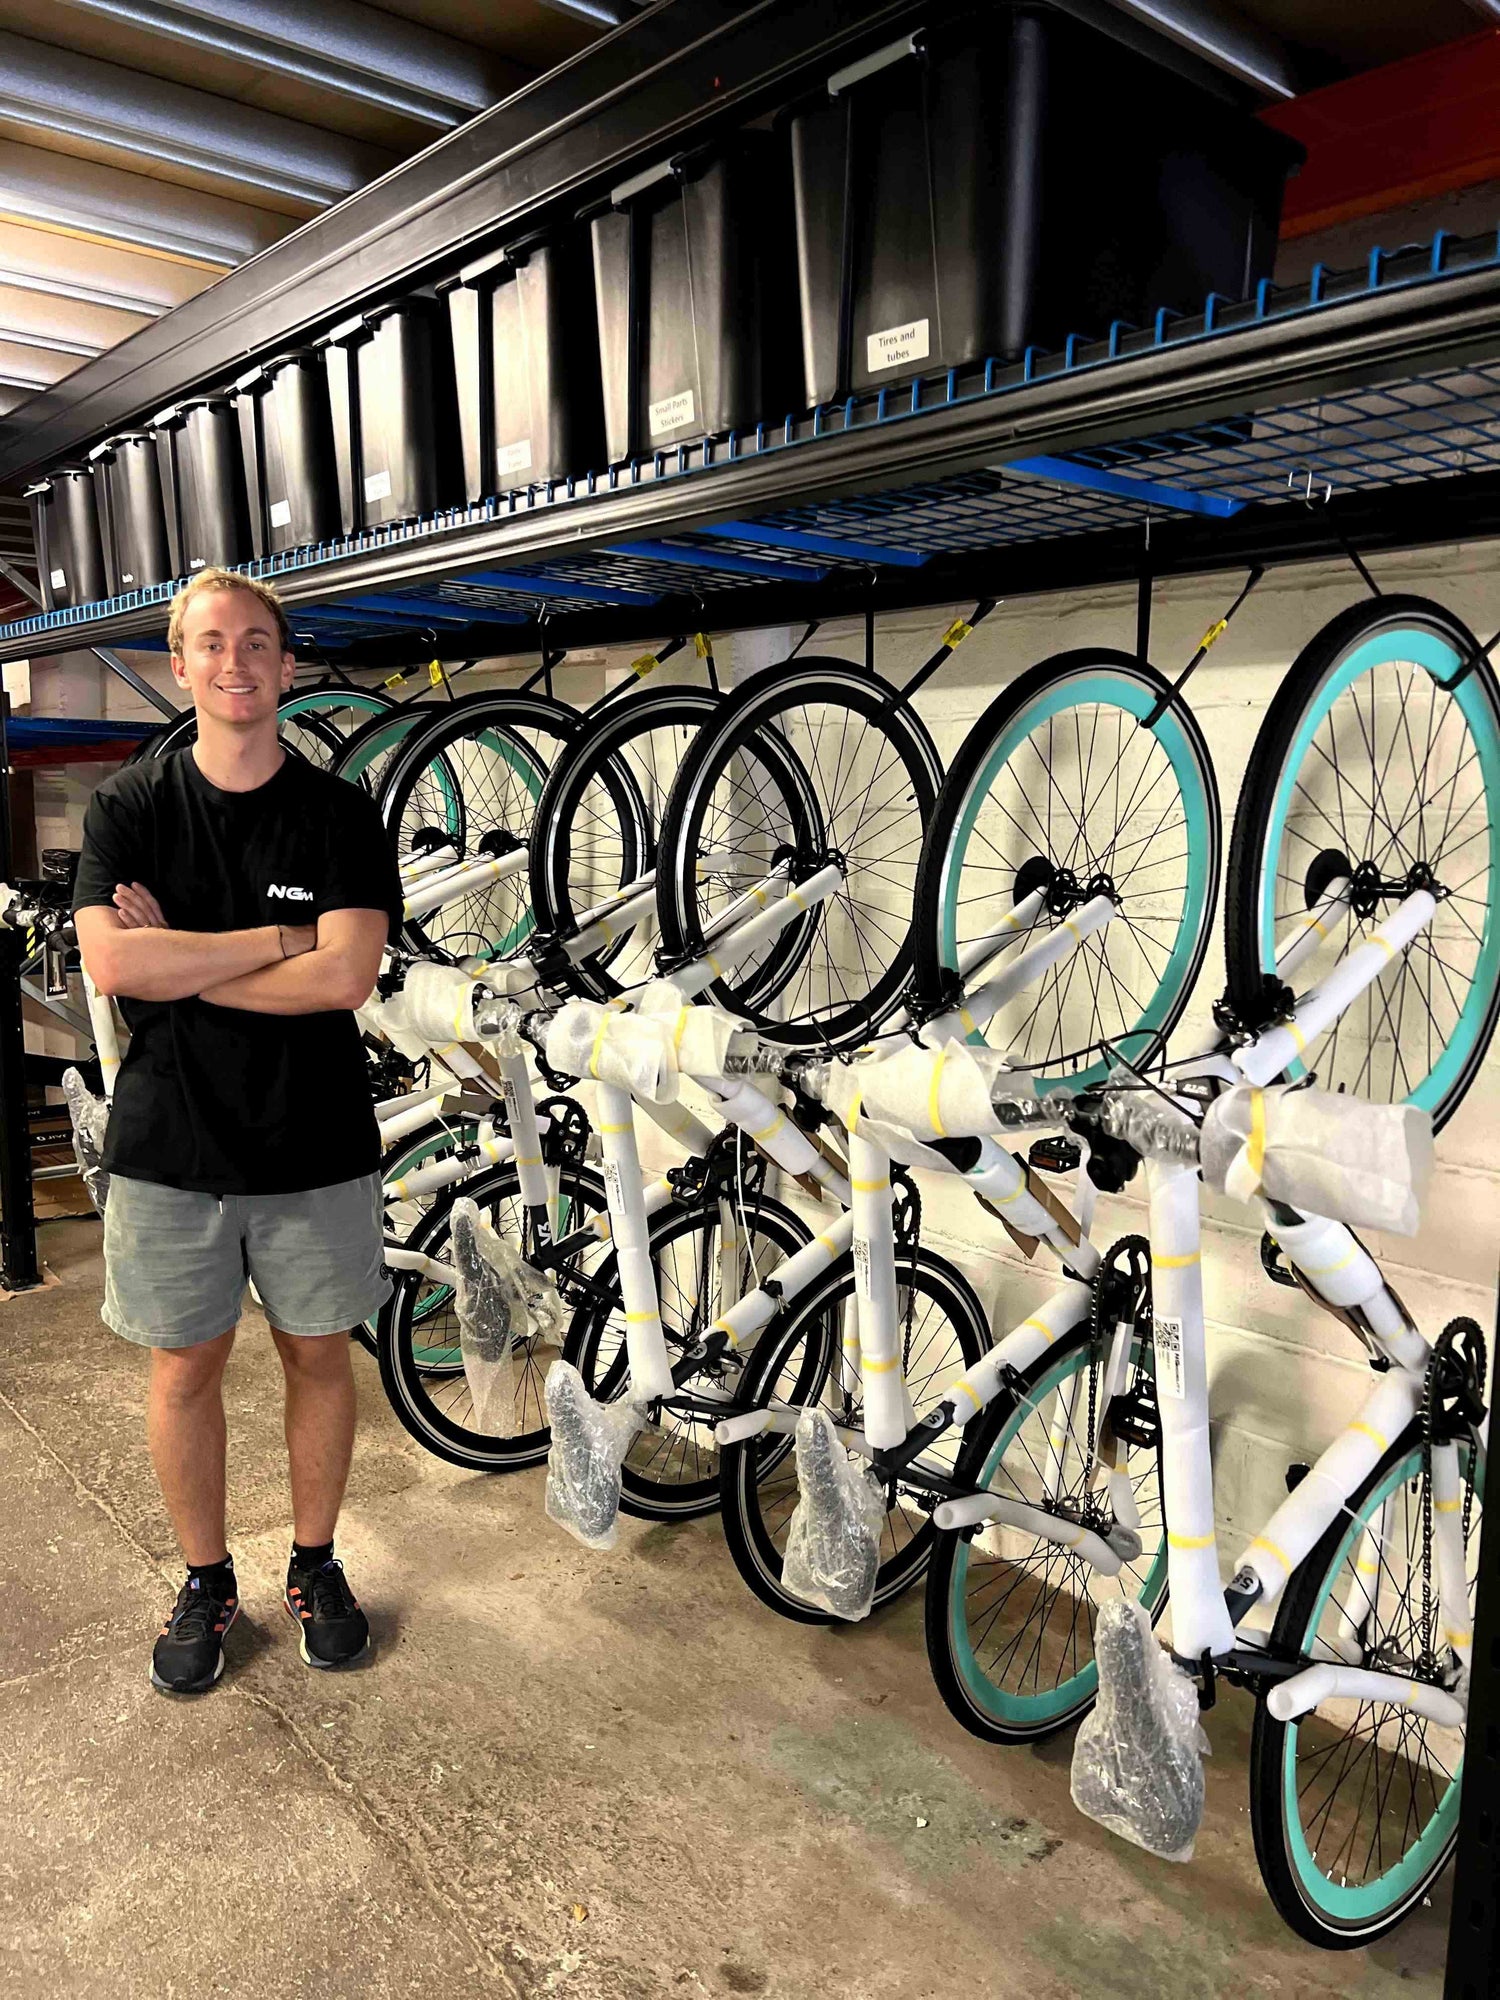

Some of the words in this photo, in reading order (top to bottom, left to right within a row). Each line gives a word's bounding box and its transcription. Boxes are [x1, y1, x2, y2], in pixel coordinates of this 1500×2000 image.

[879, 336, 898, 347] Tires
[900, 328, 915, 341] and
[887, 350, 909, 361] tubes
[655, 402, 672, 416] Small
[672, 399, 688, 409] Parts
[660, 415, 684, 427] Stickers
